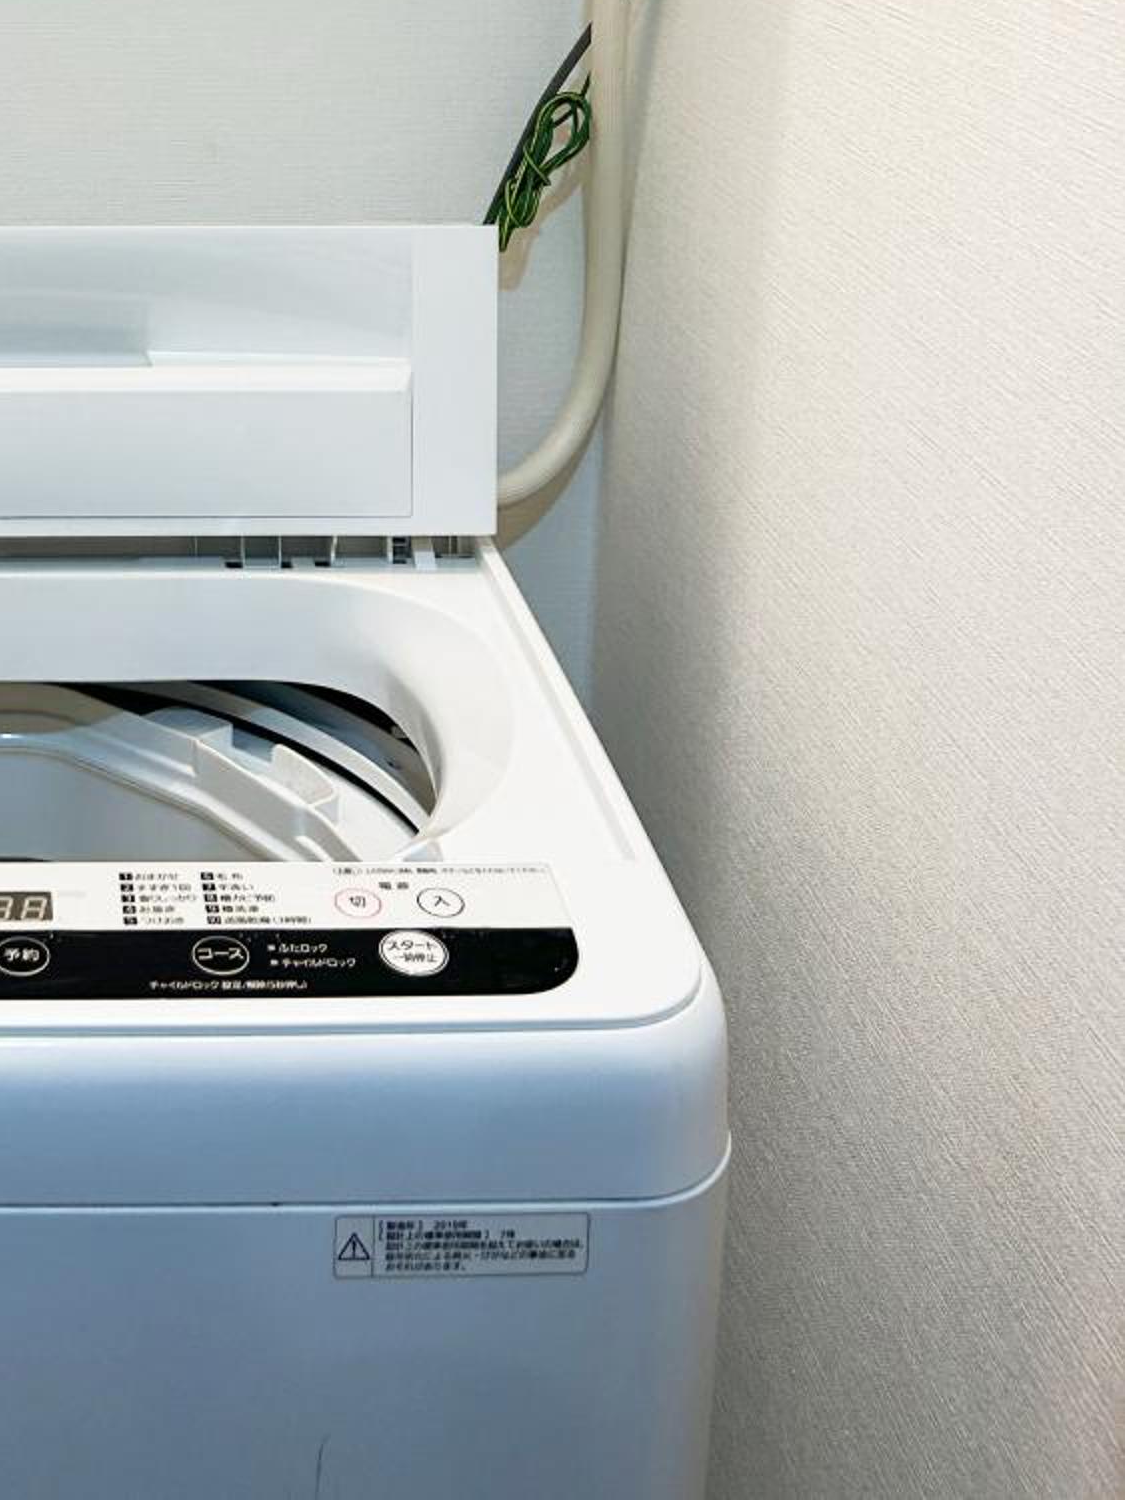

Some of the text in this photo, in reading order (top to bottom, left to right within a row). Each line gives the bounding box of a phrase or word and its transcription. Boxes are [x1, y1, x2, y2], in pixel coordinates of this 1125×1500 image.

[433, 895, 451, 907] 入
[278, 943, 328, 953] ふたロック
[387, 940, 438, 951] スタート
[4, 948, 40, 962] 予約
[197, 947, 244, 961] コース
[148, 979, 220, 990] チャイルドロック
